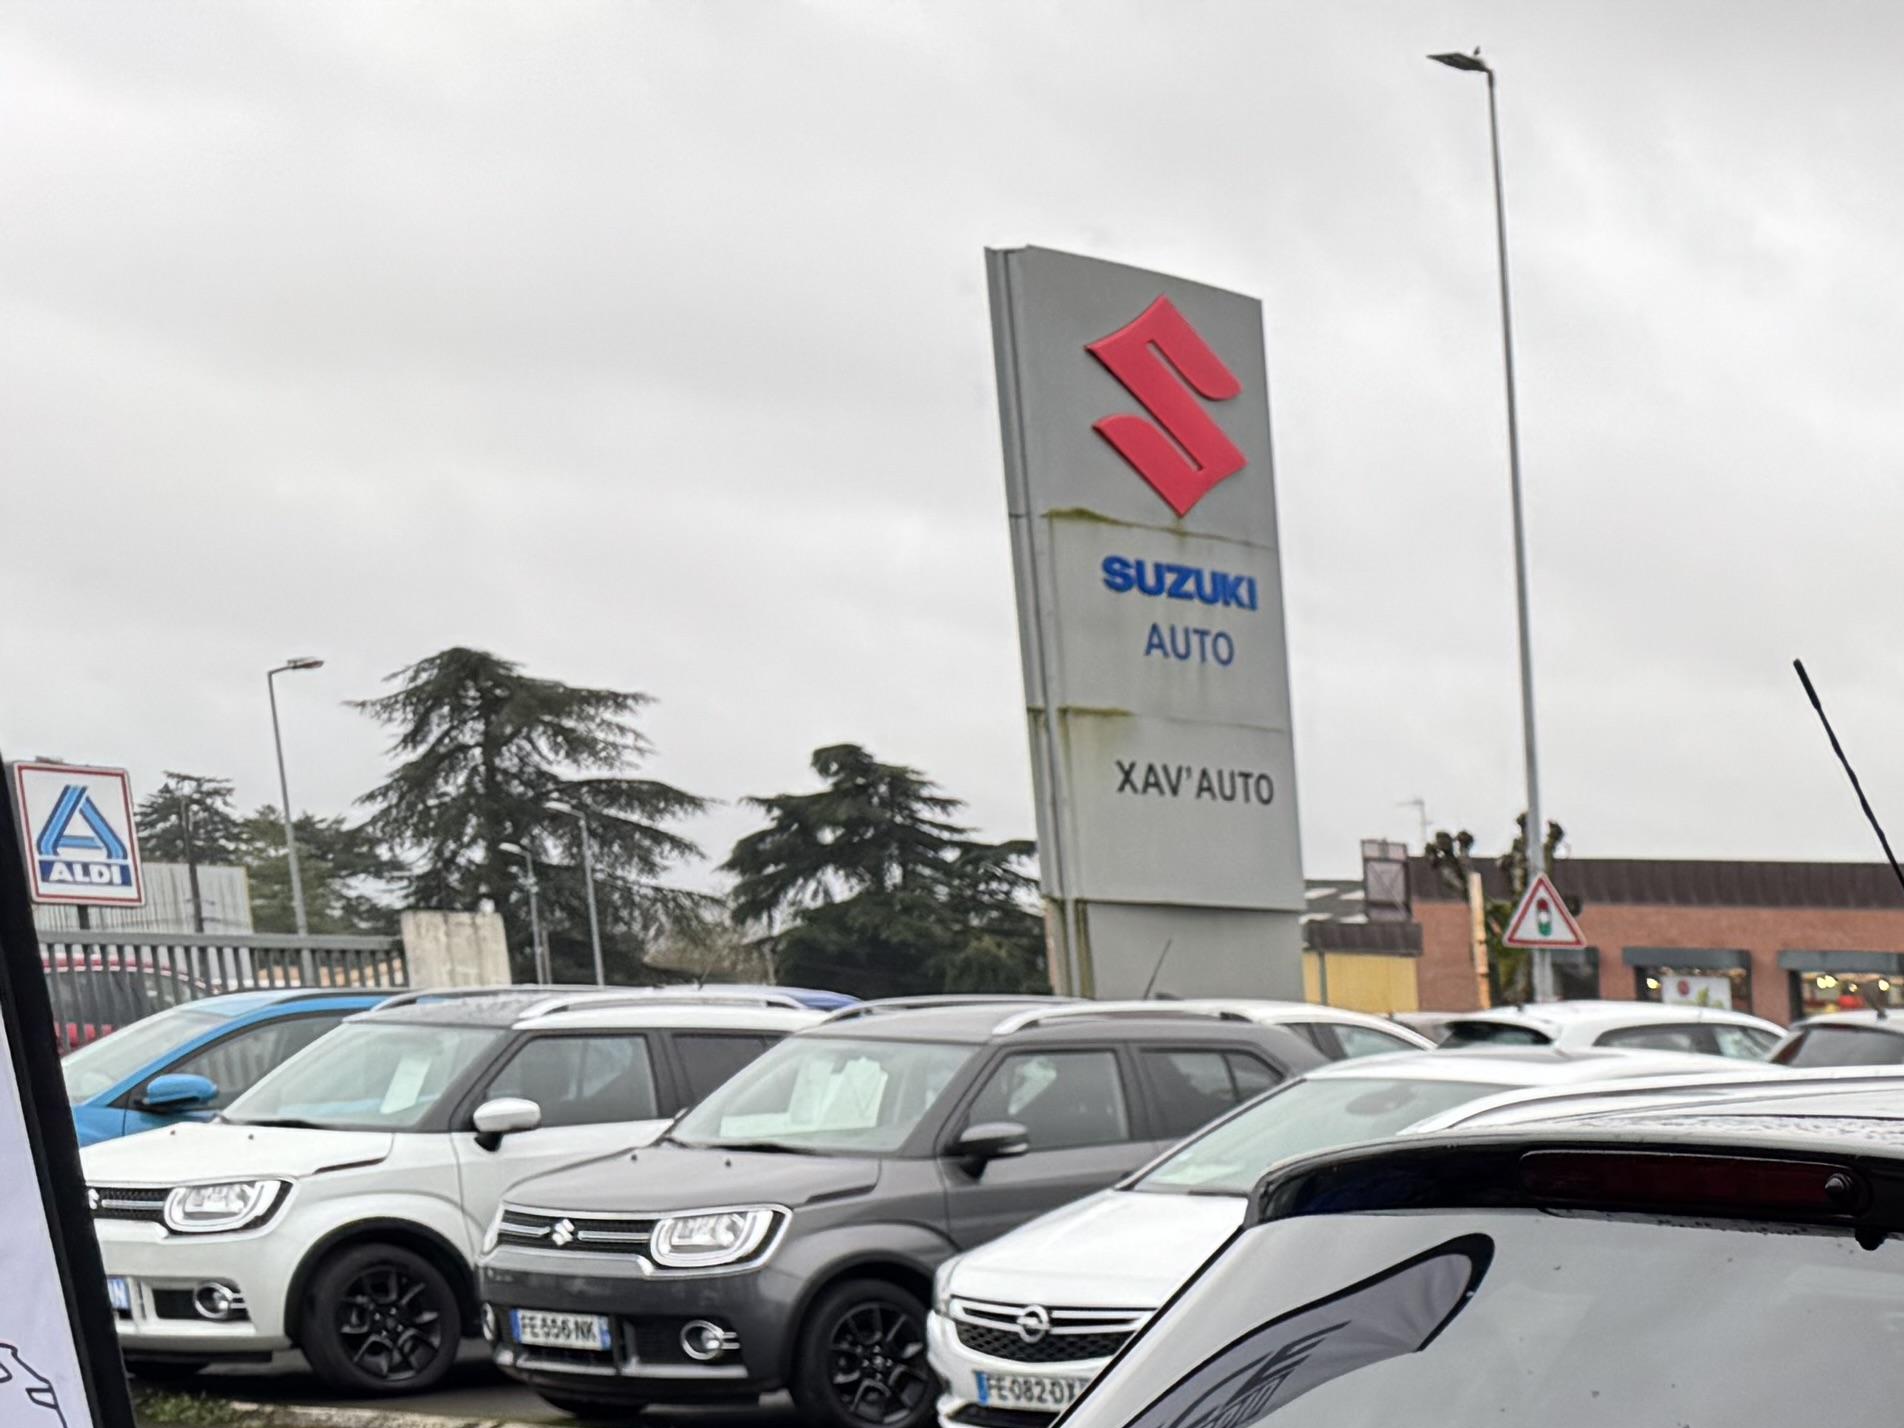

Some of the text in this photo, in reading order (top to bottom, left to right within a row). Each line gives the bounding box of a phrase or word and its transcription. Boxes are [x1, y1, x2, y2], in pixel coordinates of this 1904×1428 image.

[1102, 555, 1258, 611] SUZUKI
[1144, 622, 1235, 667] AUTO
[1115, 760, 1275, 805] XAV'AUTO
[49, 862, 122, 885] ALDI
